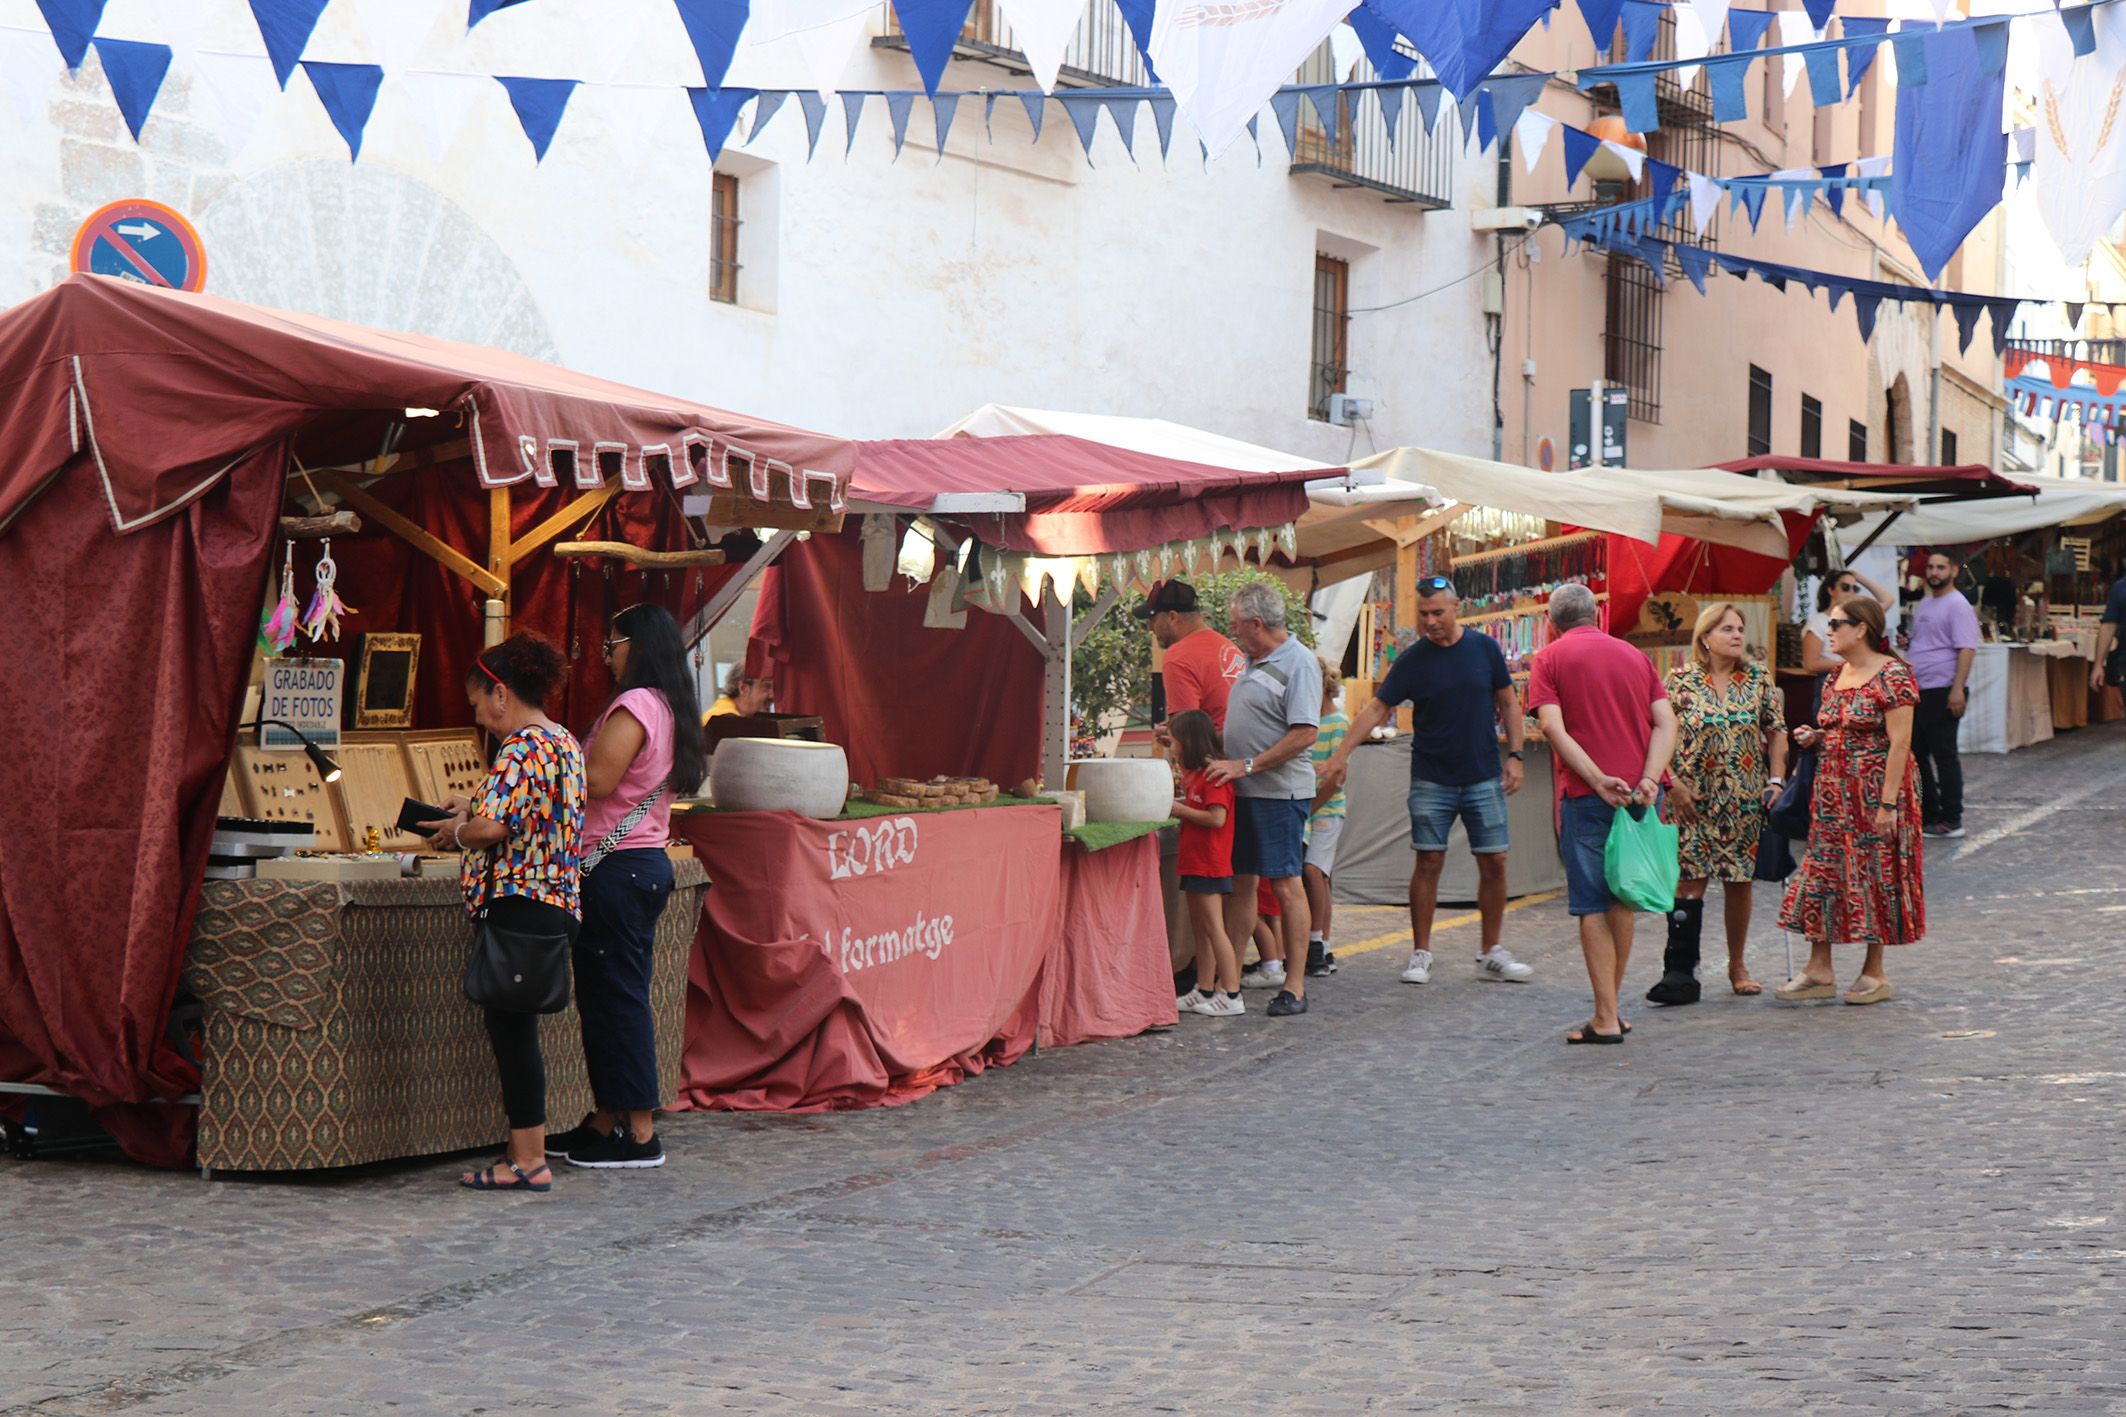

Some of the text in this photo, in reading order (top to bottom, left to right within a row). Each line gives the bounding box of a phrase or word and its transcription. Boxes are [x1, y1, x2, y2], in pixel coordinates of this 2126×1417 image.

[273, 669, 335, 690] GRABADO
[272, 696, 333, 717] DE FOTOS
[841, 911, 954, 973] formatge
